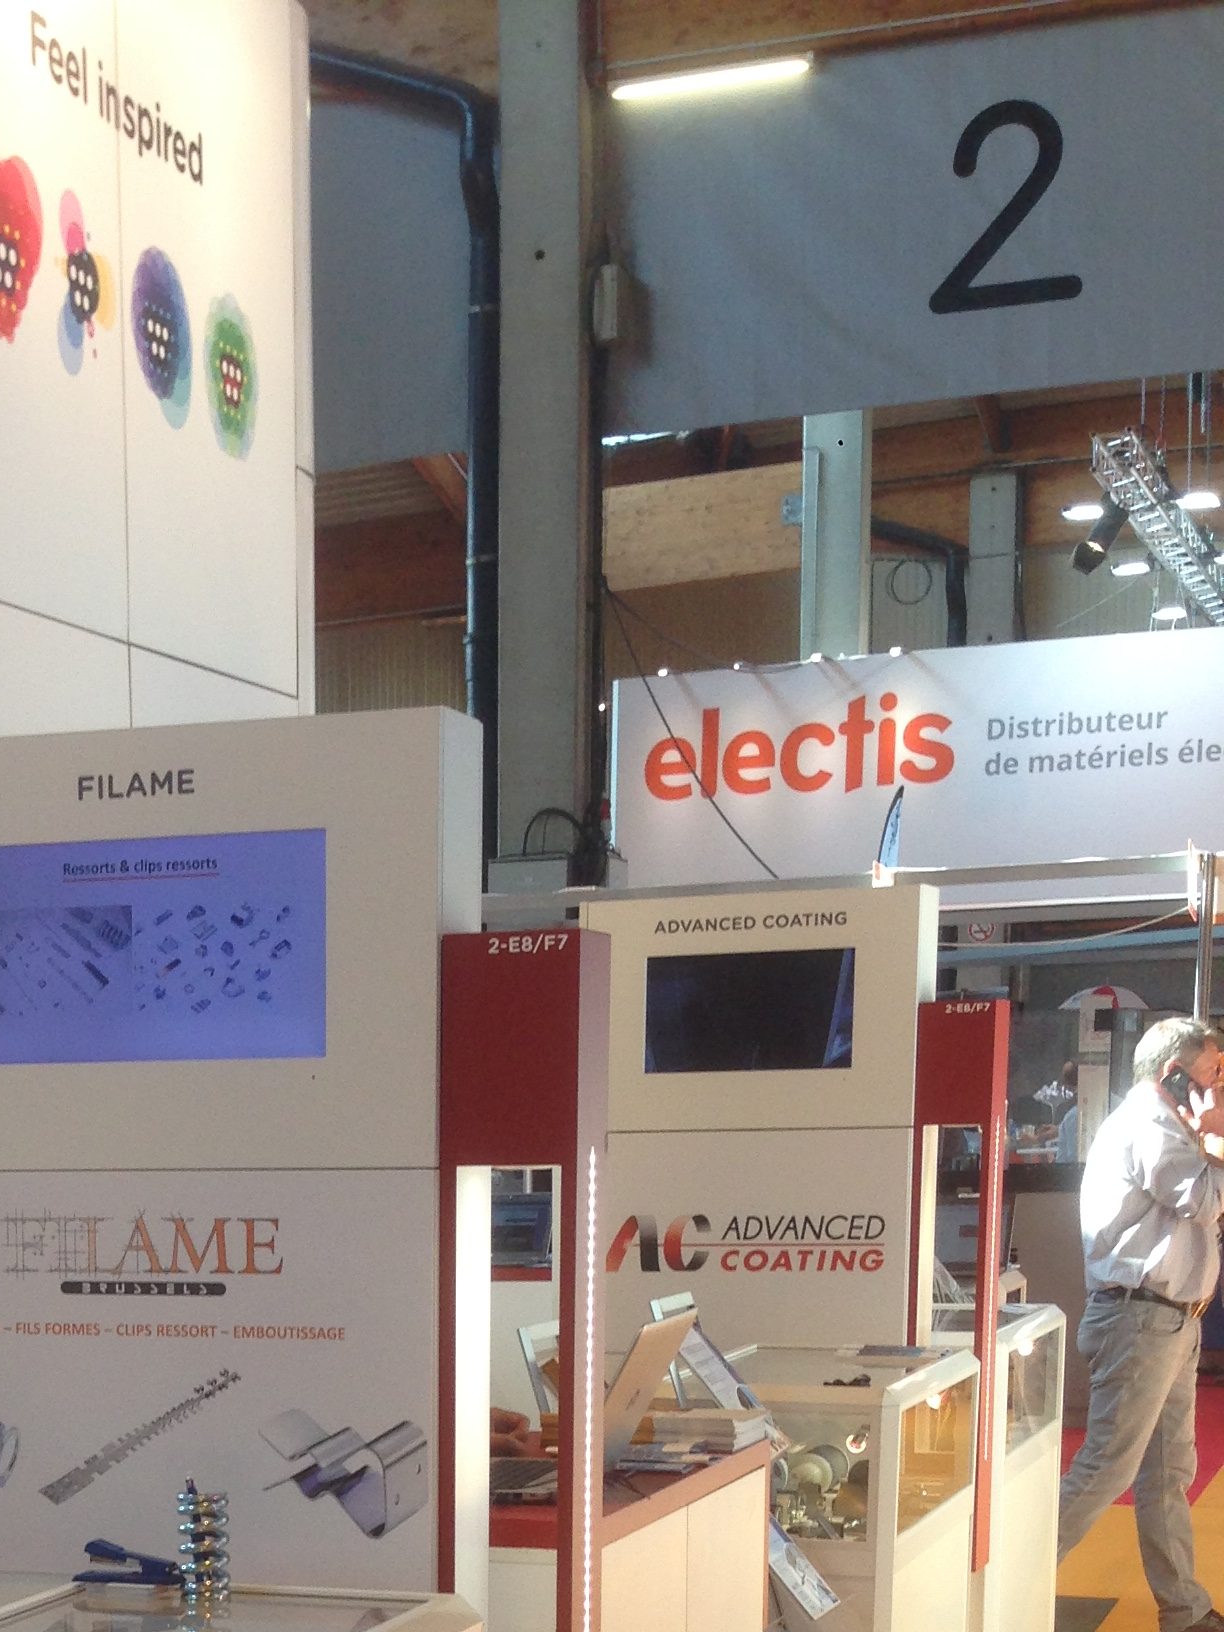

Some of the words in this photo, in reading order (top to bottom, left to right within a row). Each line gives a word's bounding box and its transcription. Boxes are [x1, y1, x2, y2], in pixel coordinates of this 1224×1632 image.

[30, 11, 88, 105] Feel
[98, 60, 204, 186] inspired
[929, 99, 1083, 315] 2
[987, 707, 1170, 742] Distributeur
[644, 691, 956, 801] electis
[984, 748, 1020, 777] de
[1029, 741, 1169, 776] matériels
[1179, 738, 1224, 765] éle
[78, 769, 195, 801] FILAME
[62, 860, 116, 876] Ressorts
[119, 860, 130, 874] &
[134, 858, 163, 874] clips
[166, 857, 218, 873] ressorts
[654, 915, 756, 935] ADVANCED
[762, 911, 848, 930] COATING
[488, 934, 569, 955] 2-E8/F7
[721, 1215, 886, 1240] ADVANCED
[0, 1212, 284, 1277] FILAME
[720, 1249, 885, 1273] COATING
[15, 1322, 41, 1336] FILS
[45, 1322, 101, 1337] FORMES
[116, 1323, 152, 1337] CLIPS
[156, 1323, 217, 1338] RESSORT
[233, 1325, 346, 1341] EMBOUTISSAGE
